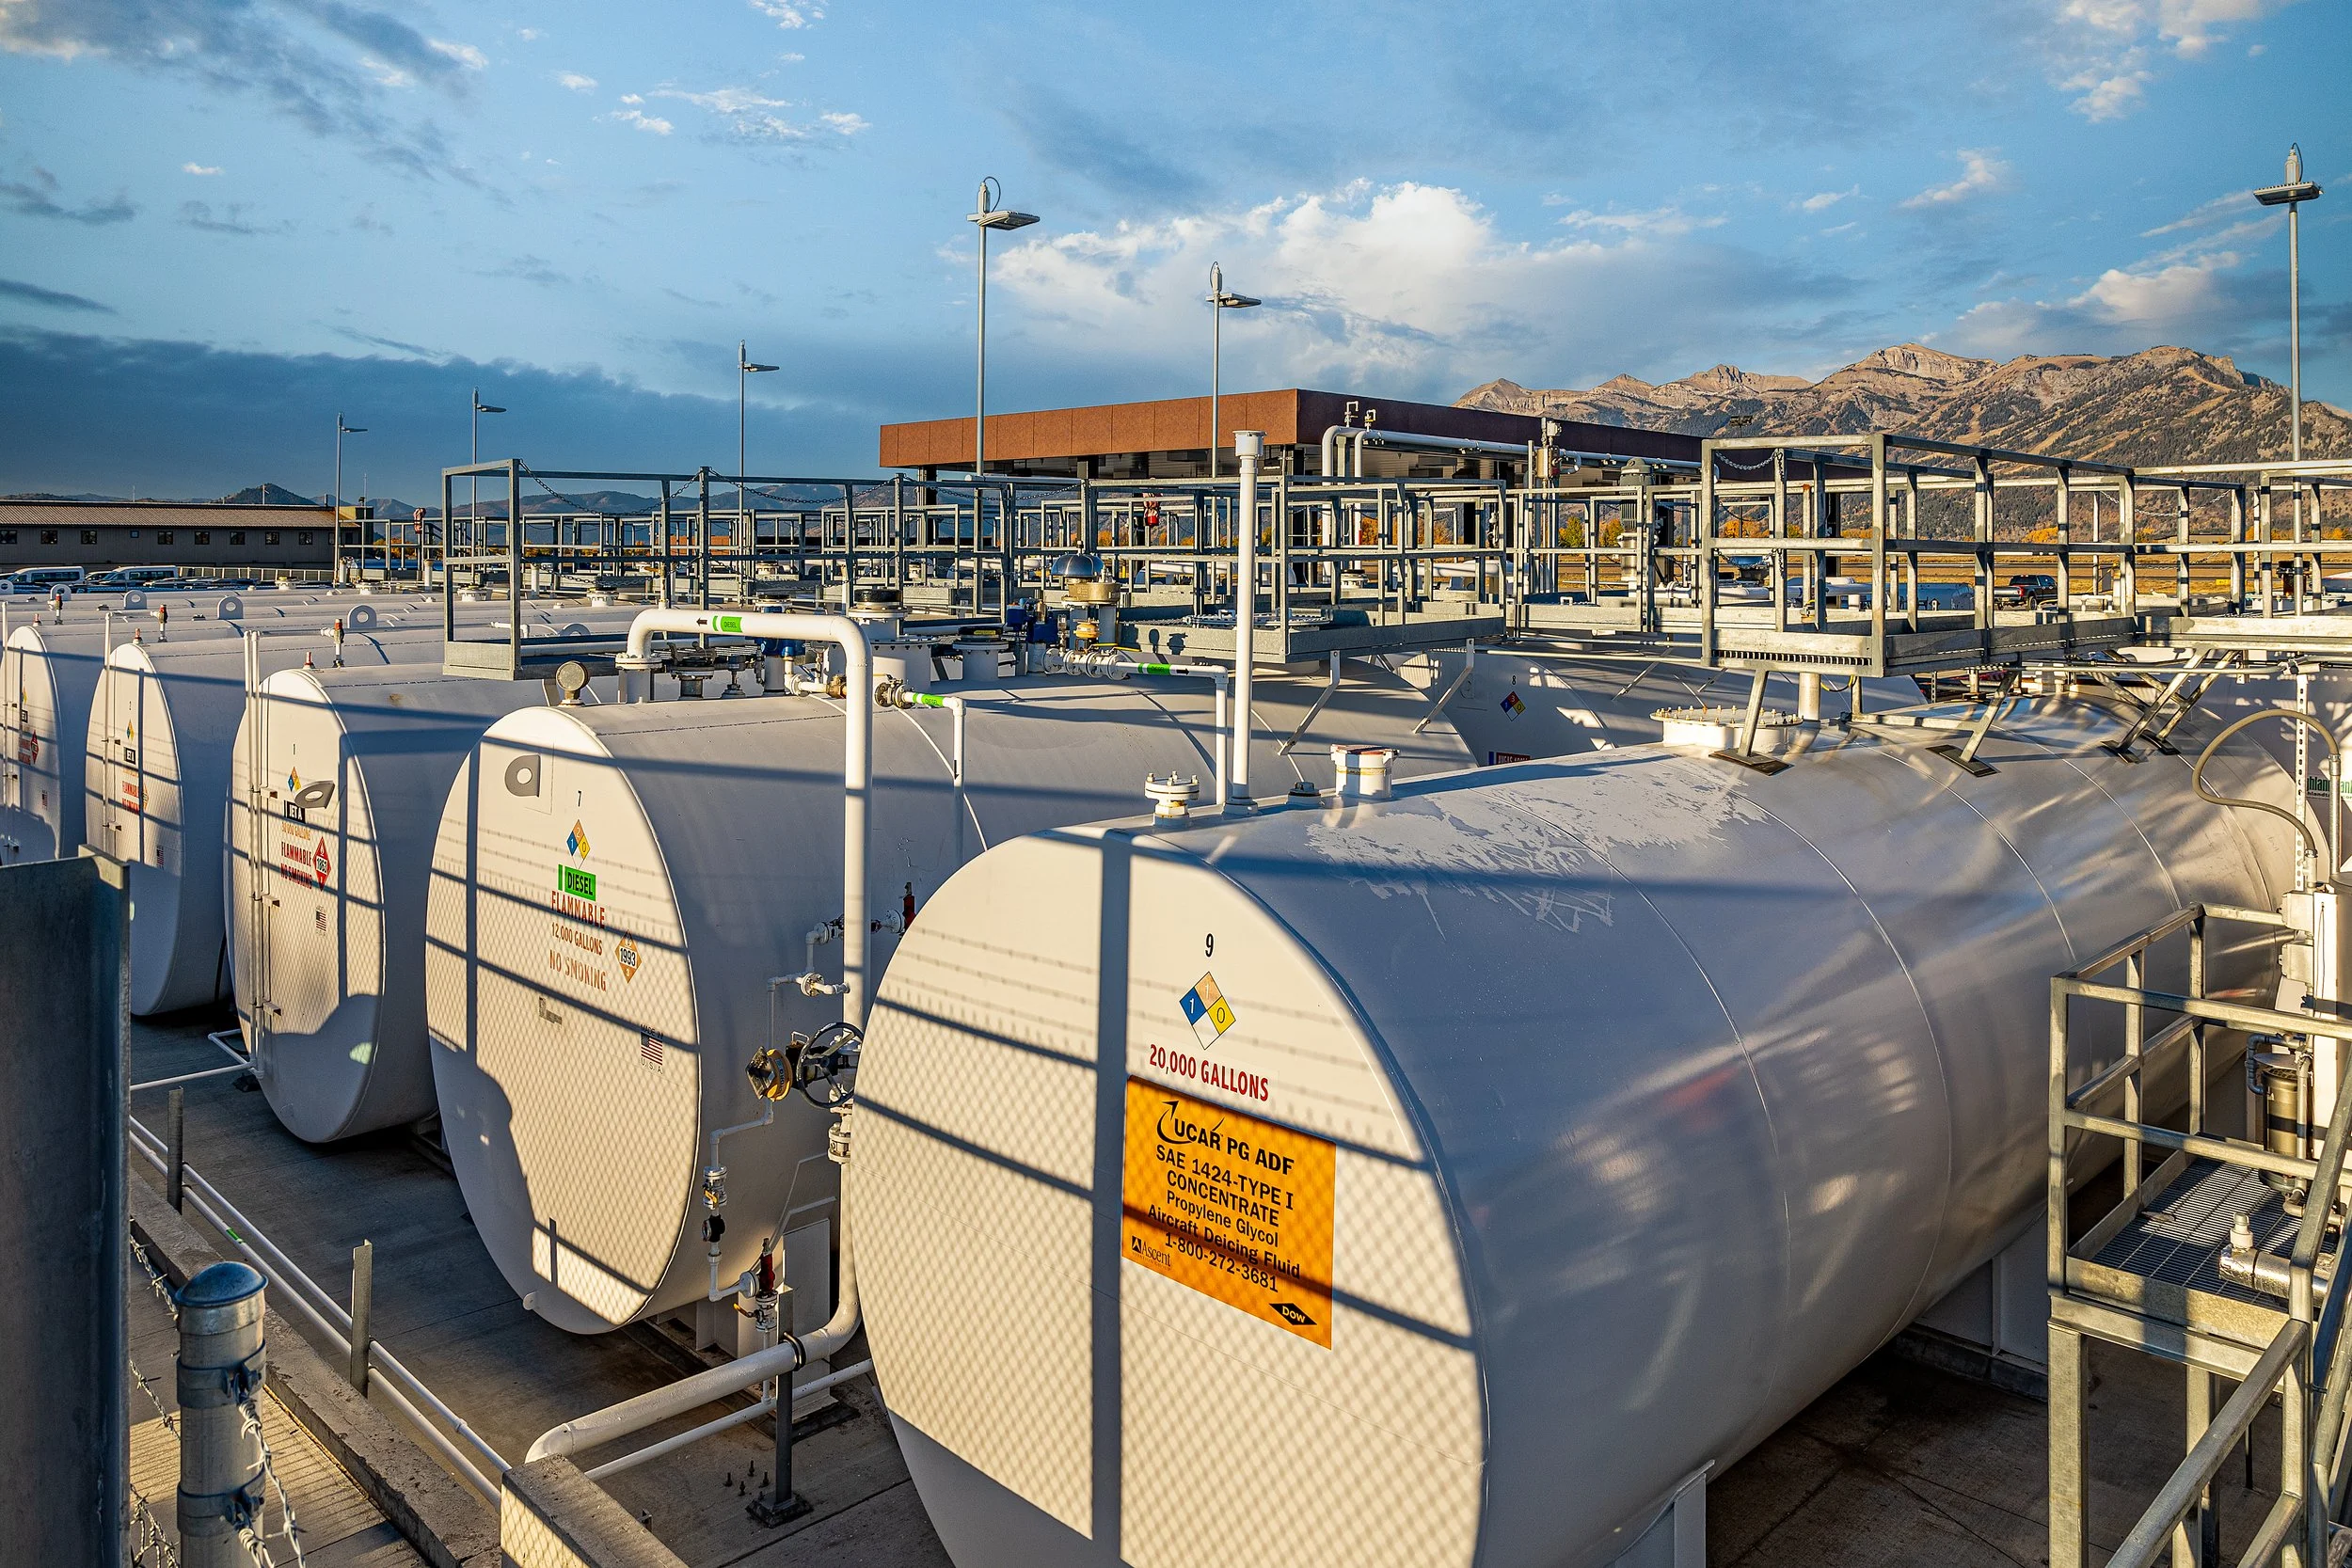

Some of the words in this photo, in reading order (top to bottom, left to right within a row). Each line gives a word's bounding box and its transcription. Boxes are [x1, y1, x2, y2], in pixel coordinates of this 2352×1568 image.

[1512, 675, 1517, 685] 8
[578, 790, 582, 807] 7
[576, 827, 580, 838] 2
[281, 841, 312, 867] FLAMMABLE
[581, 841, 587, 853] 0
[280, 863, 288, 880] NO
[288, 864, 313, 890] SMOKING
[567, 871, 594, 896] DIESEL
[551, 890, 605, 929] FLAMMABLE
[551, 922, 573, 944] 12,000
[574, 930, 603, 956] GALLONS
[1205, 933, 1214, 958] 9
[620, 947, 636, 967] 1993
[549, 949, 562, 973] NO
[564, 957, 607, 992] SMOKING
[626, 968, 630, 977] 3
[1204, 983, 1210, 1000] 1
[1189, 997, 1195, 1014] 1
[1216, 1006, 1226, 1024] 0
[641, 1023, 656, 1036] MADE
[1149, 1043, 1197, 1080] 20,000
[1200, 1059, 1269, 1102] GALLONS
[1174, 1117, 1221, 1151] UCAR
[1227, 1136, 1249, 1162] PG
[1255, 1148, 1295, 1176] ADF
[1155, 1144, 1186, 1170] SAE
[1192, 1158, 1281, 1206] 1424-TYPE
[1285, 1191, 1294, 1211] I
[1167, 1169, 1279, 1227] CONCENTRATE
[1167, 1190, 1232, 1228] Propylene
[1235, 1217, 1279, 1247] Glycol
[1141, 1241, 1171, 1267] Ascent
[1147, 1204, 1199, 1239] Aircraft
[1203, 1226, 1259, 1265] Deicing
[1263, 1250, 1300, 1279] Fluid
[1165, 1231, 1279, 1293] 1-800-272-3681
